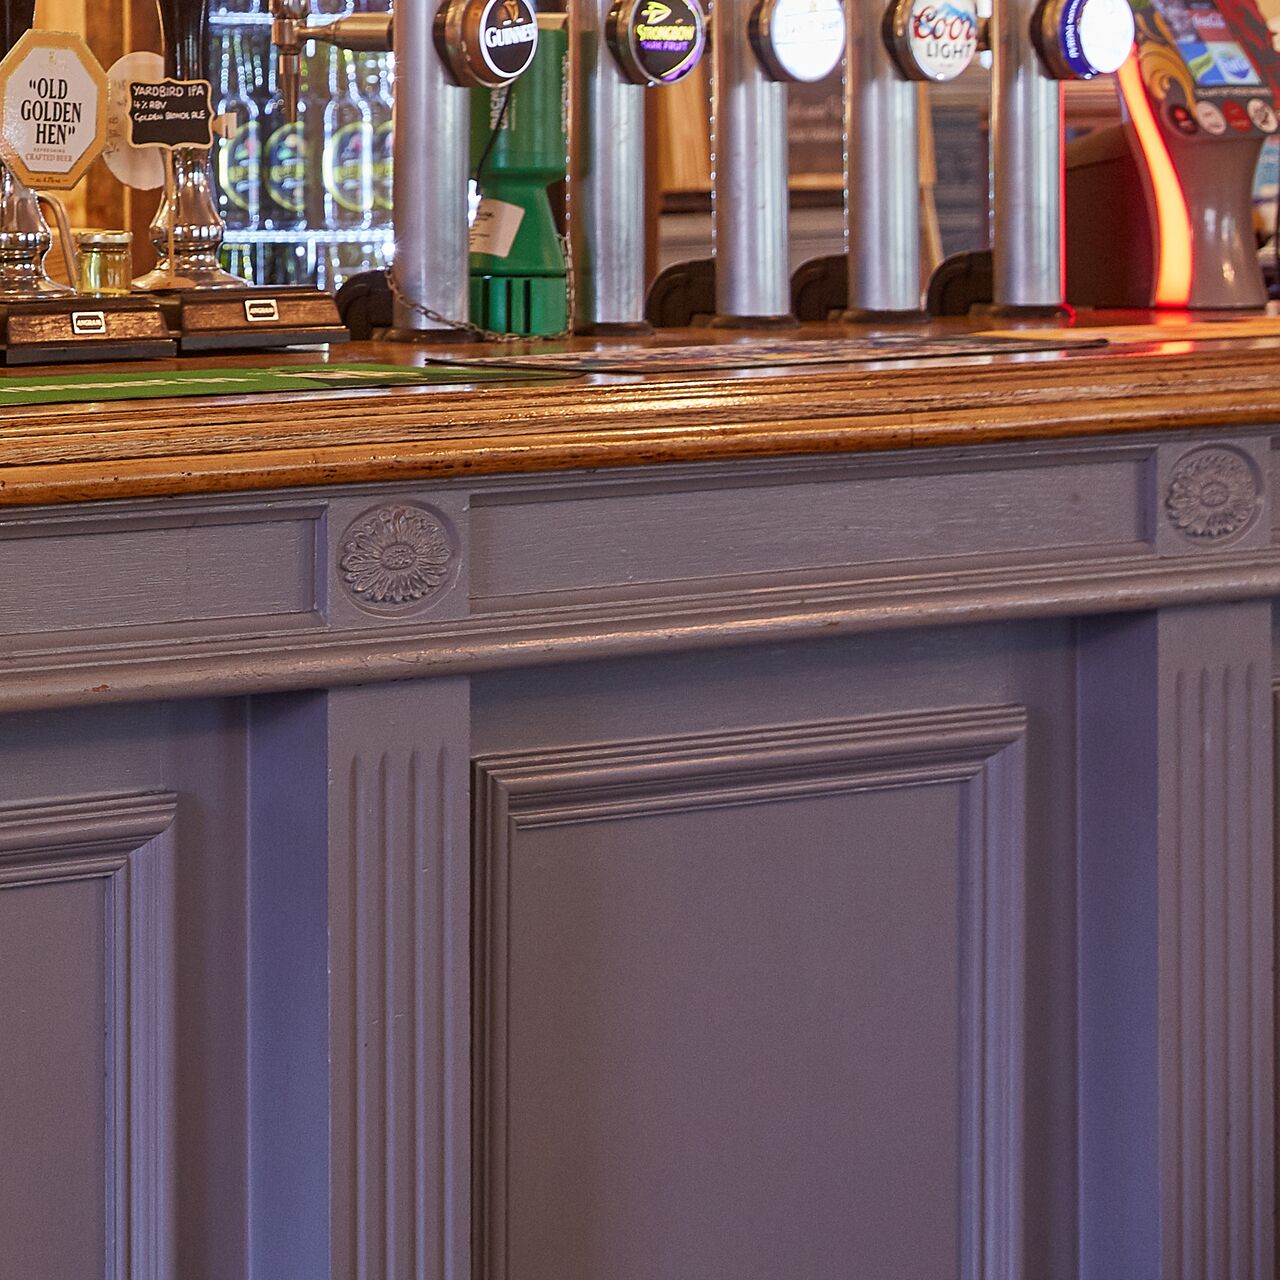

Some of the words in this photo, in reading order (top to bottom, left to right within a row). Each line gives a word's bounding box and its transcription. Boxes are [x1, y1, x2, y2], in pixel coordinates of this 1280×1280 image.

[636, 24, 695, 42] STRONGBOW
[926, 42, 972, 59] LIGHT
[133, 84, 184, 97] YARDBIRD
[188, 85, 205, 96] IPA
[21, 100, 82, 123] GOLDEN
[191, 110, 206, 119] ALE
[25, 154, 56, 162] CRAFTED
[56, 154, 72, 162] BEER
